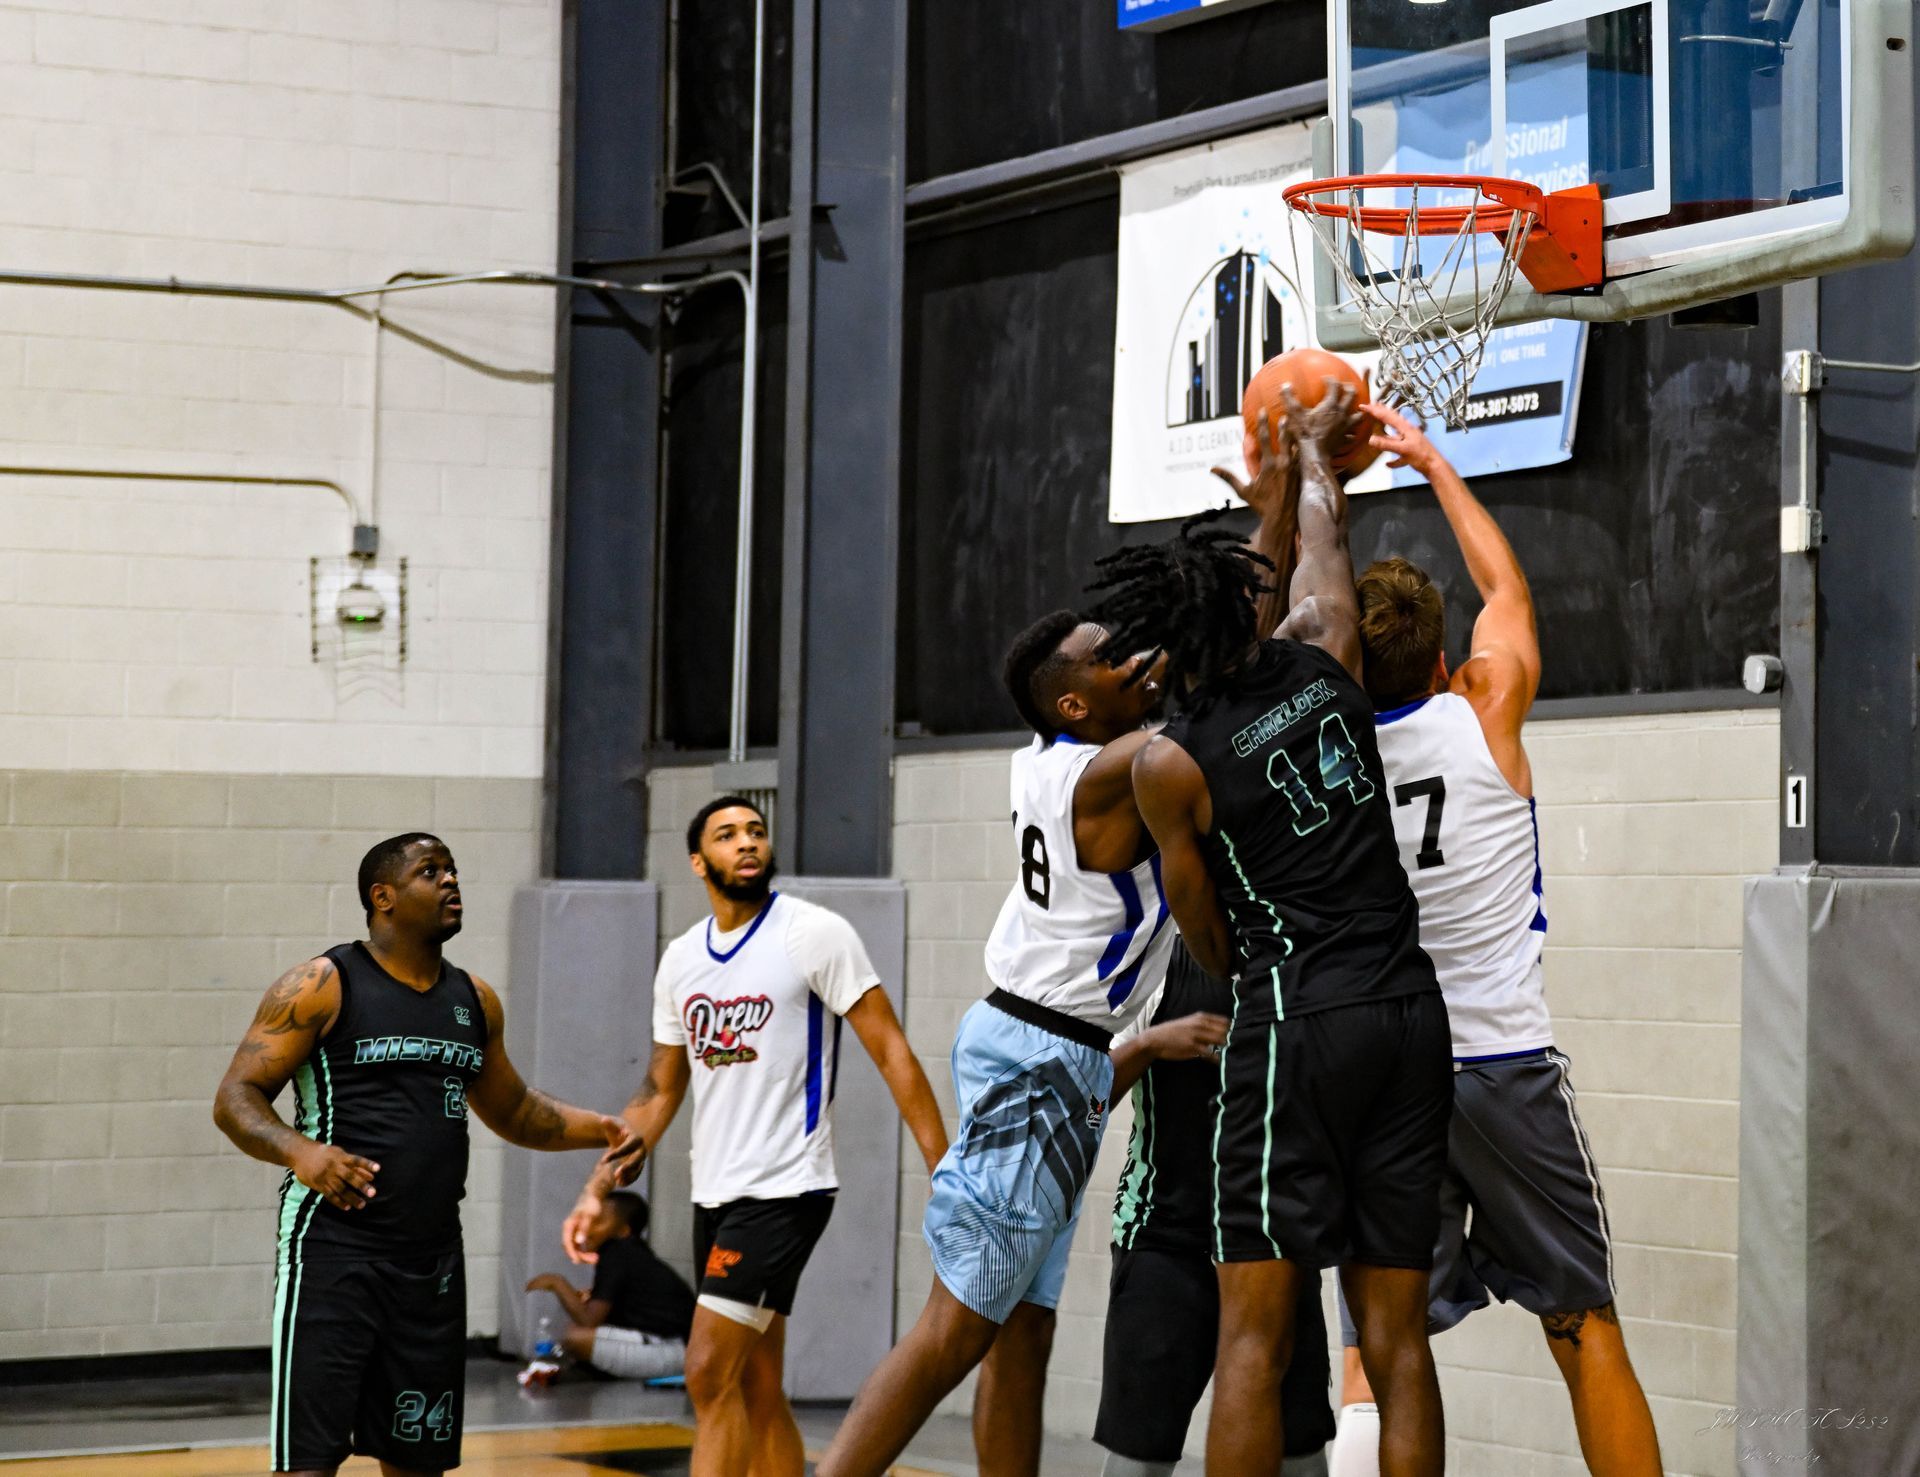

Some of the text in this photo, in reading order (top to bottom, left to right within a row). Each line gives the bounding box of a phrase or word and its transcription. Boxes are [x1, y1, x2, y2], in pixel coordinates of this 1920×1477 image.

[1464, 115, 1568, 174] Prosional
[1522, 342, 1546, 360] TIME
[1266, 712, 1375, 837] 14
[1792, 779, 1802, 825] 1
[1394, 775, 1447, 870] 7
[1011, 809, 1051, 912] 8
[684, 995, 771, 1056] Drew
[443, 1075, 469, 1120] 2
[392, 1390, 454, 1441] 24
